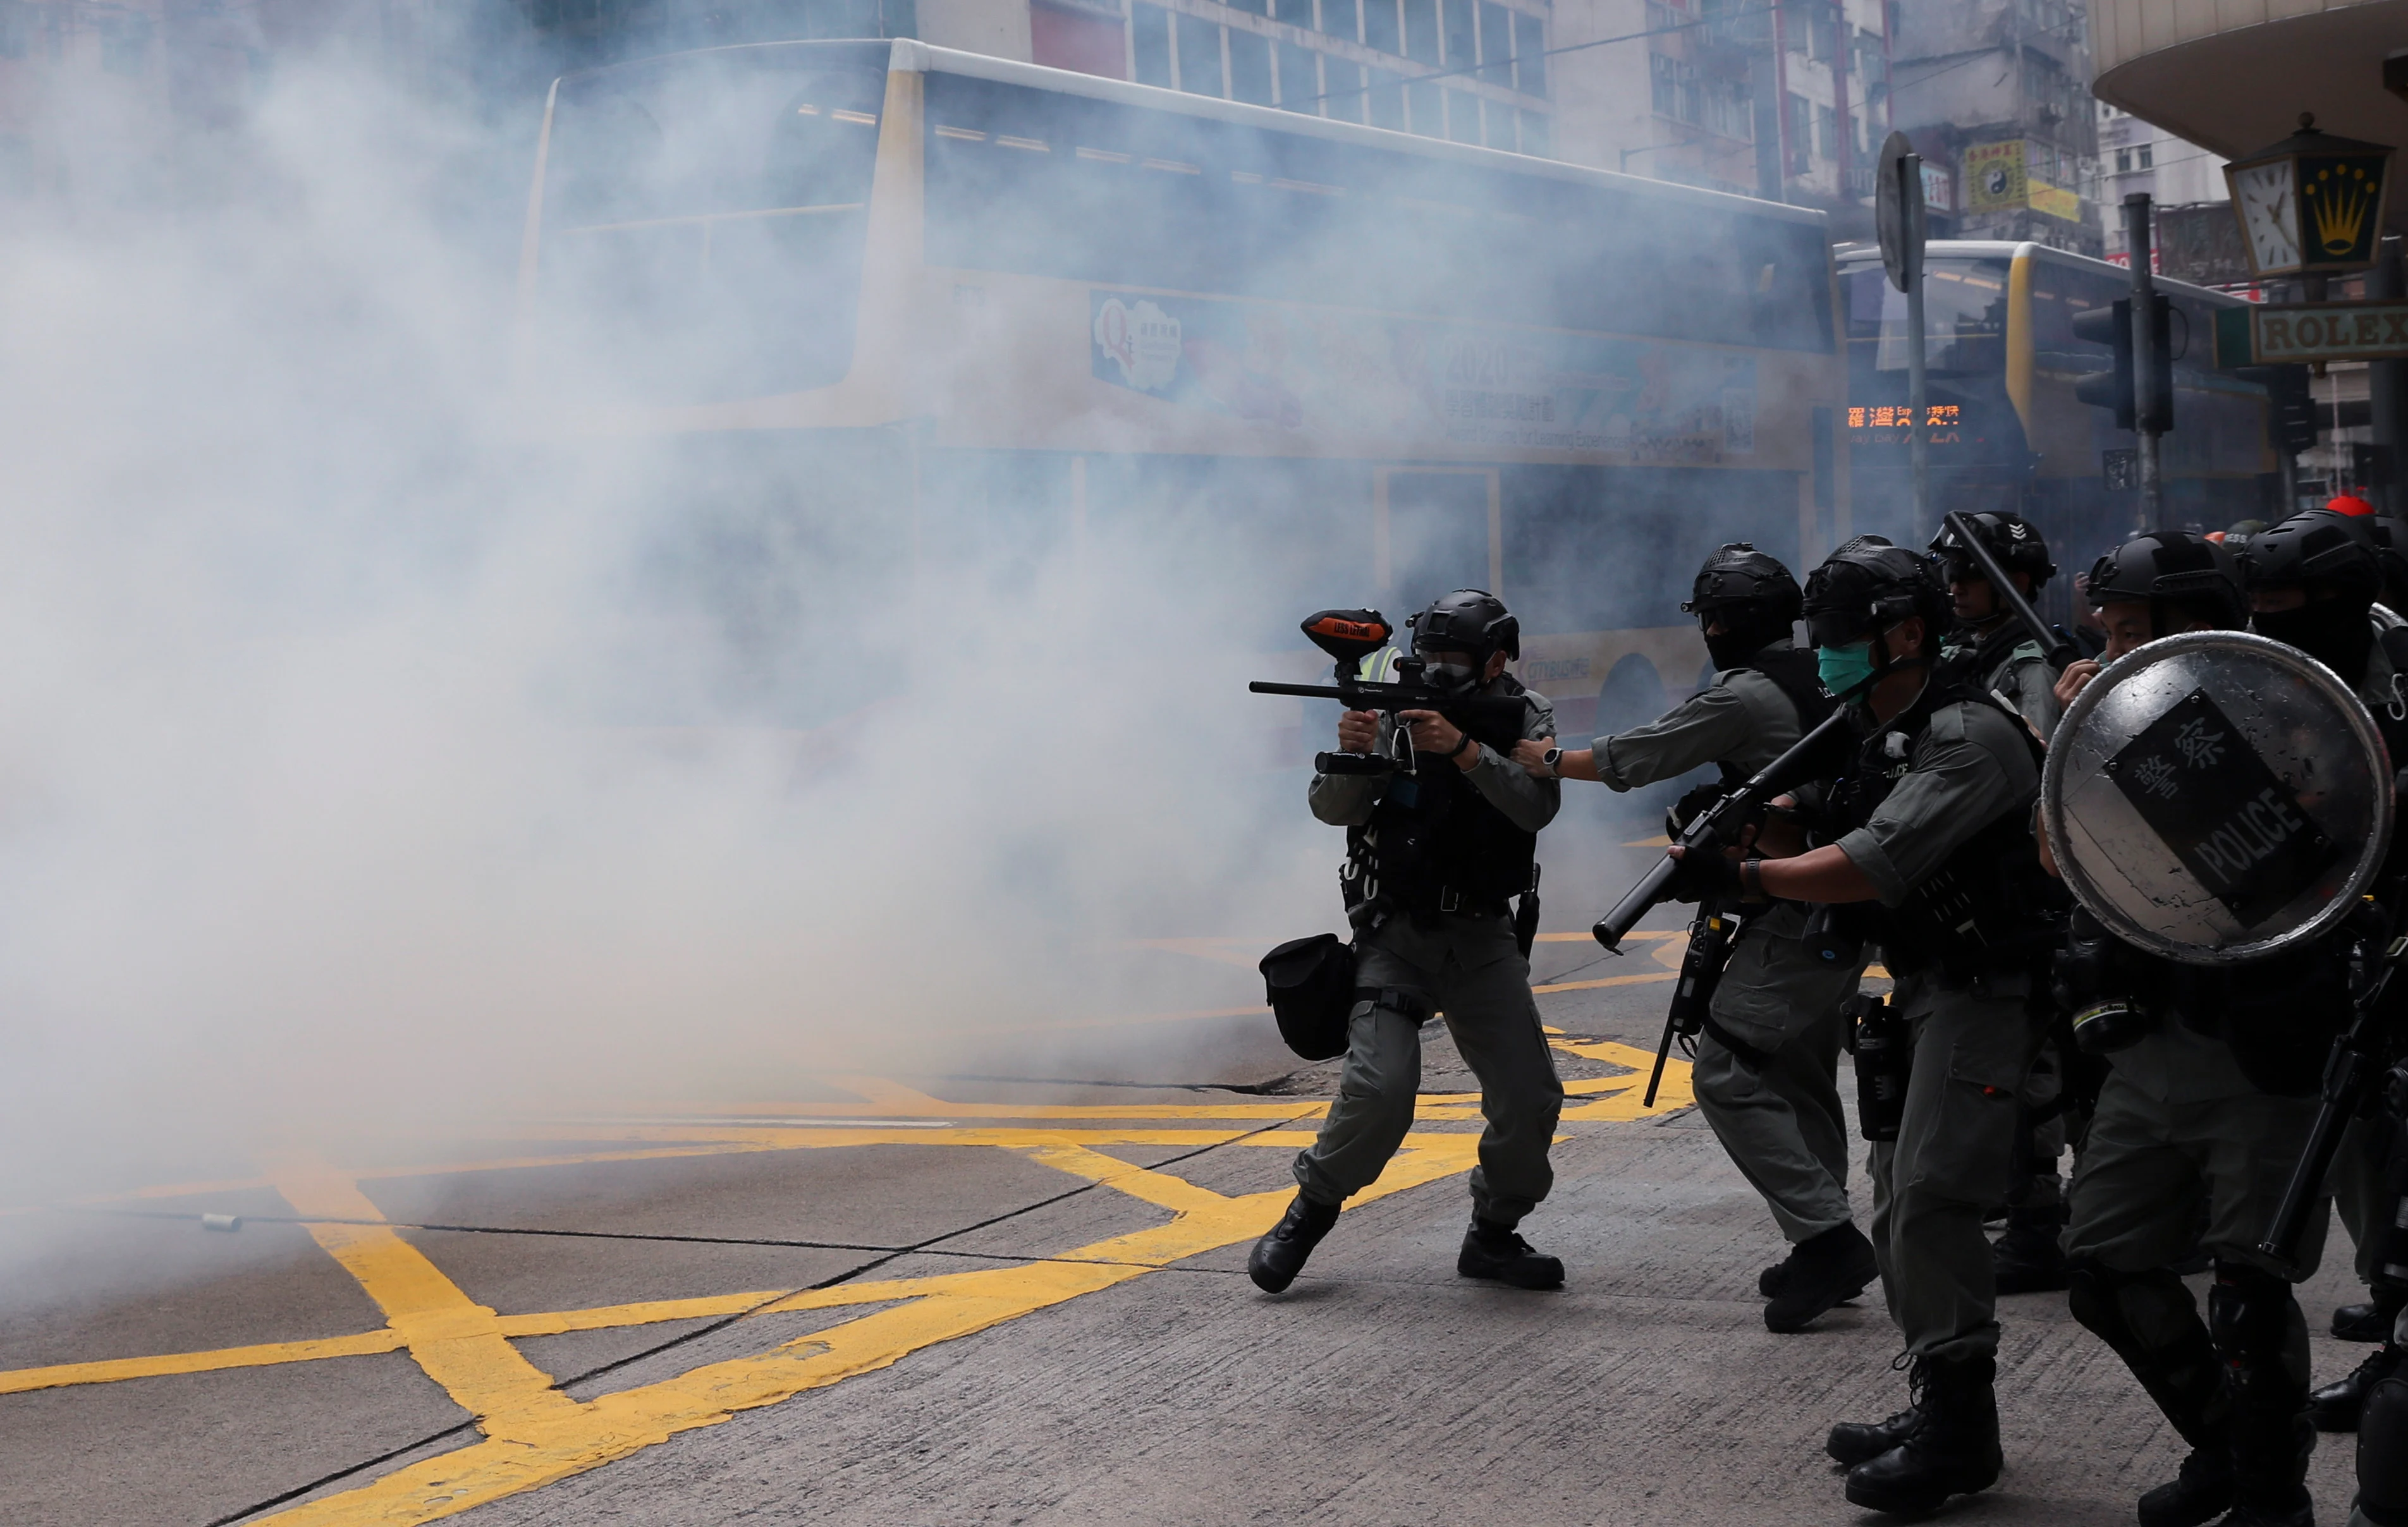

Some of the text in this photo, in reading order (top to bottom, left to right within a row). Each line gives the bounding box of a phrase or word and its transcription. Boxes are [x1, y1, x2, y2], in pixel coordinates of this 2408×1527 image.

[2263, 312, 2408, 350] ROLEX
[1334, 622, 1349, 635] LESS
[2134, 717, 2227, 800] 警察
[2193, 786, 2303, 885] POLICE
